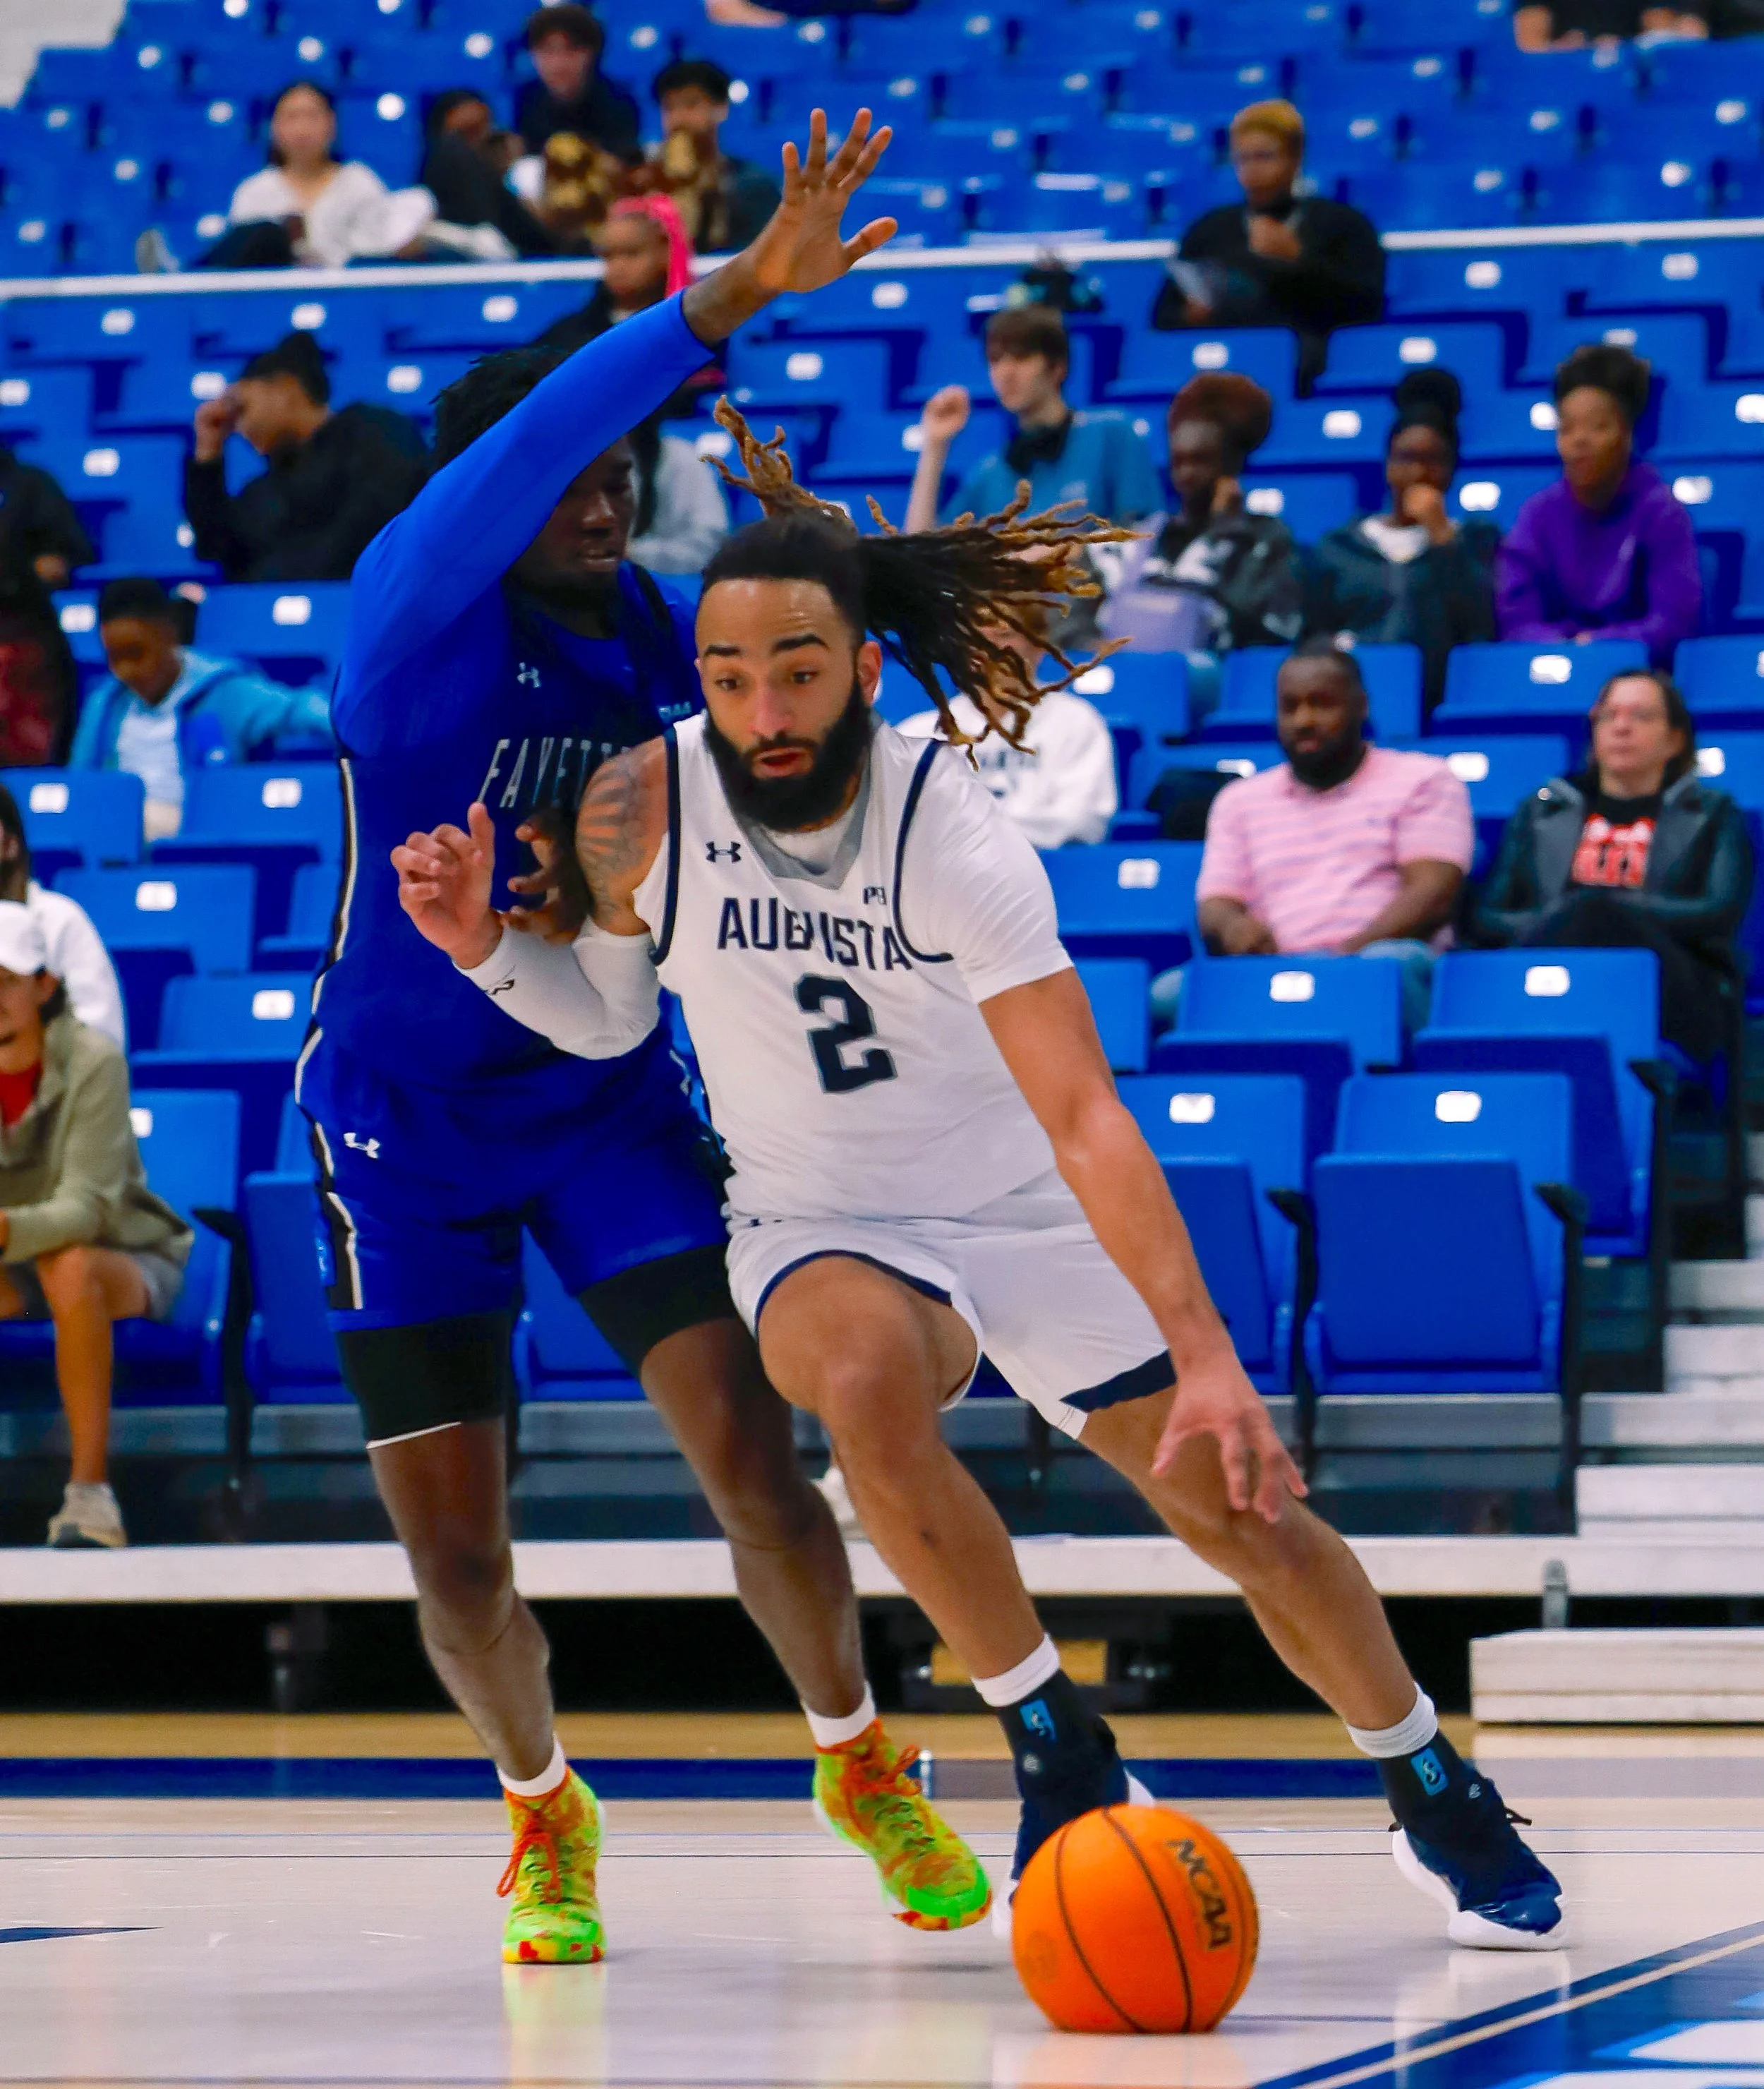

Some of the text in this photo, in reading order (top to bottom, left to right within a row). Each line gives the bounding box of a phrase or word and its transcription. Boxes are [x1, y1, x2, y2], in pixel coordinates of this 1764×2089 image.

[477, 737, 632, 809] FAYET
[792, 971, 899, 1095] 2
[1165, 1839, 1232, 1950] NCAA
